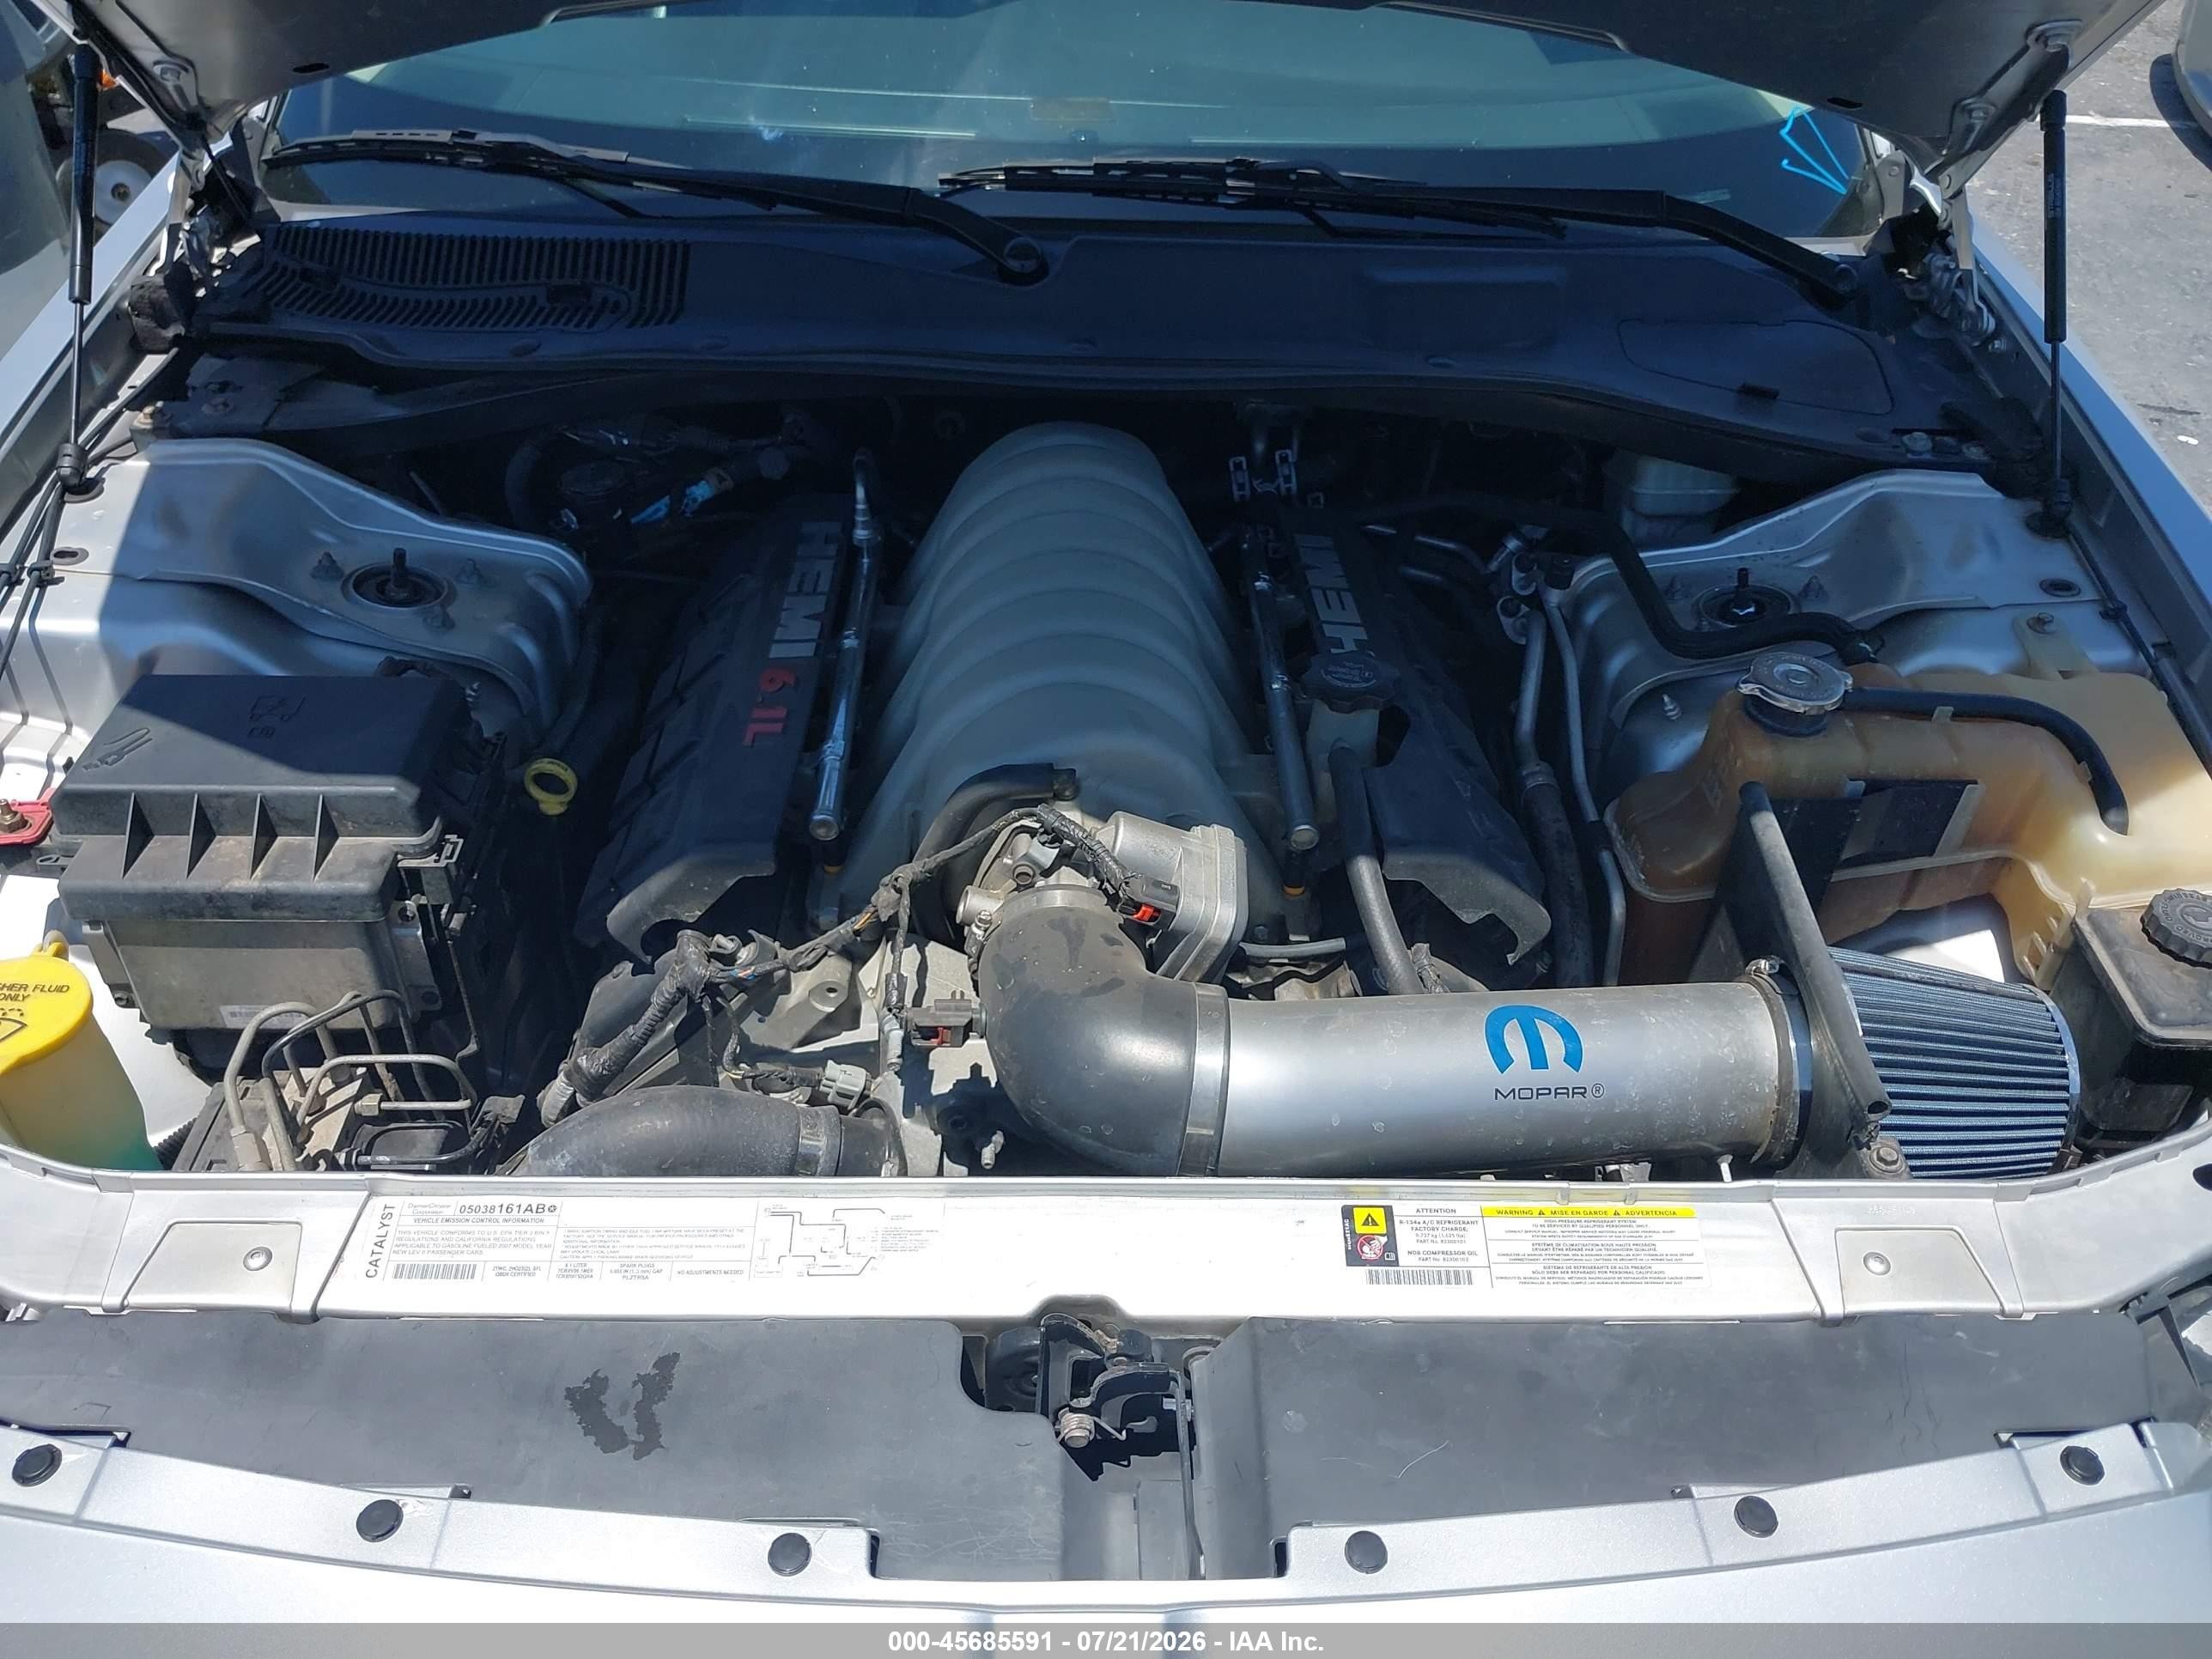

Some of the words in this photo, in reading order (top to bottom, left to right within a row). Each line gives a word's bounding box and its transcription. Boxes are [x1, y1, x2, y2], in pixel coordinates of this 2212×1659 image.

[769, 521, 842, 659] HEMI
[32, 984, 70, 994] FLUID
[0, 993, 31, 1002] ONLY
[459, 1204, 546, 1214] 05038161AB
[365, 1204, 396, 1279] CATALYST
